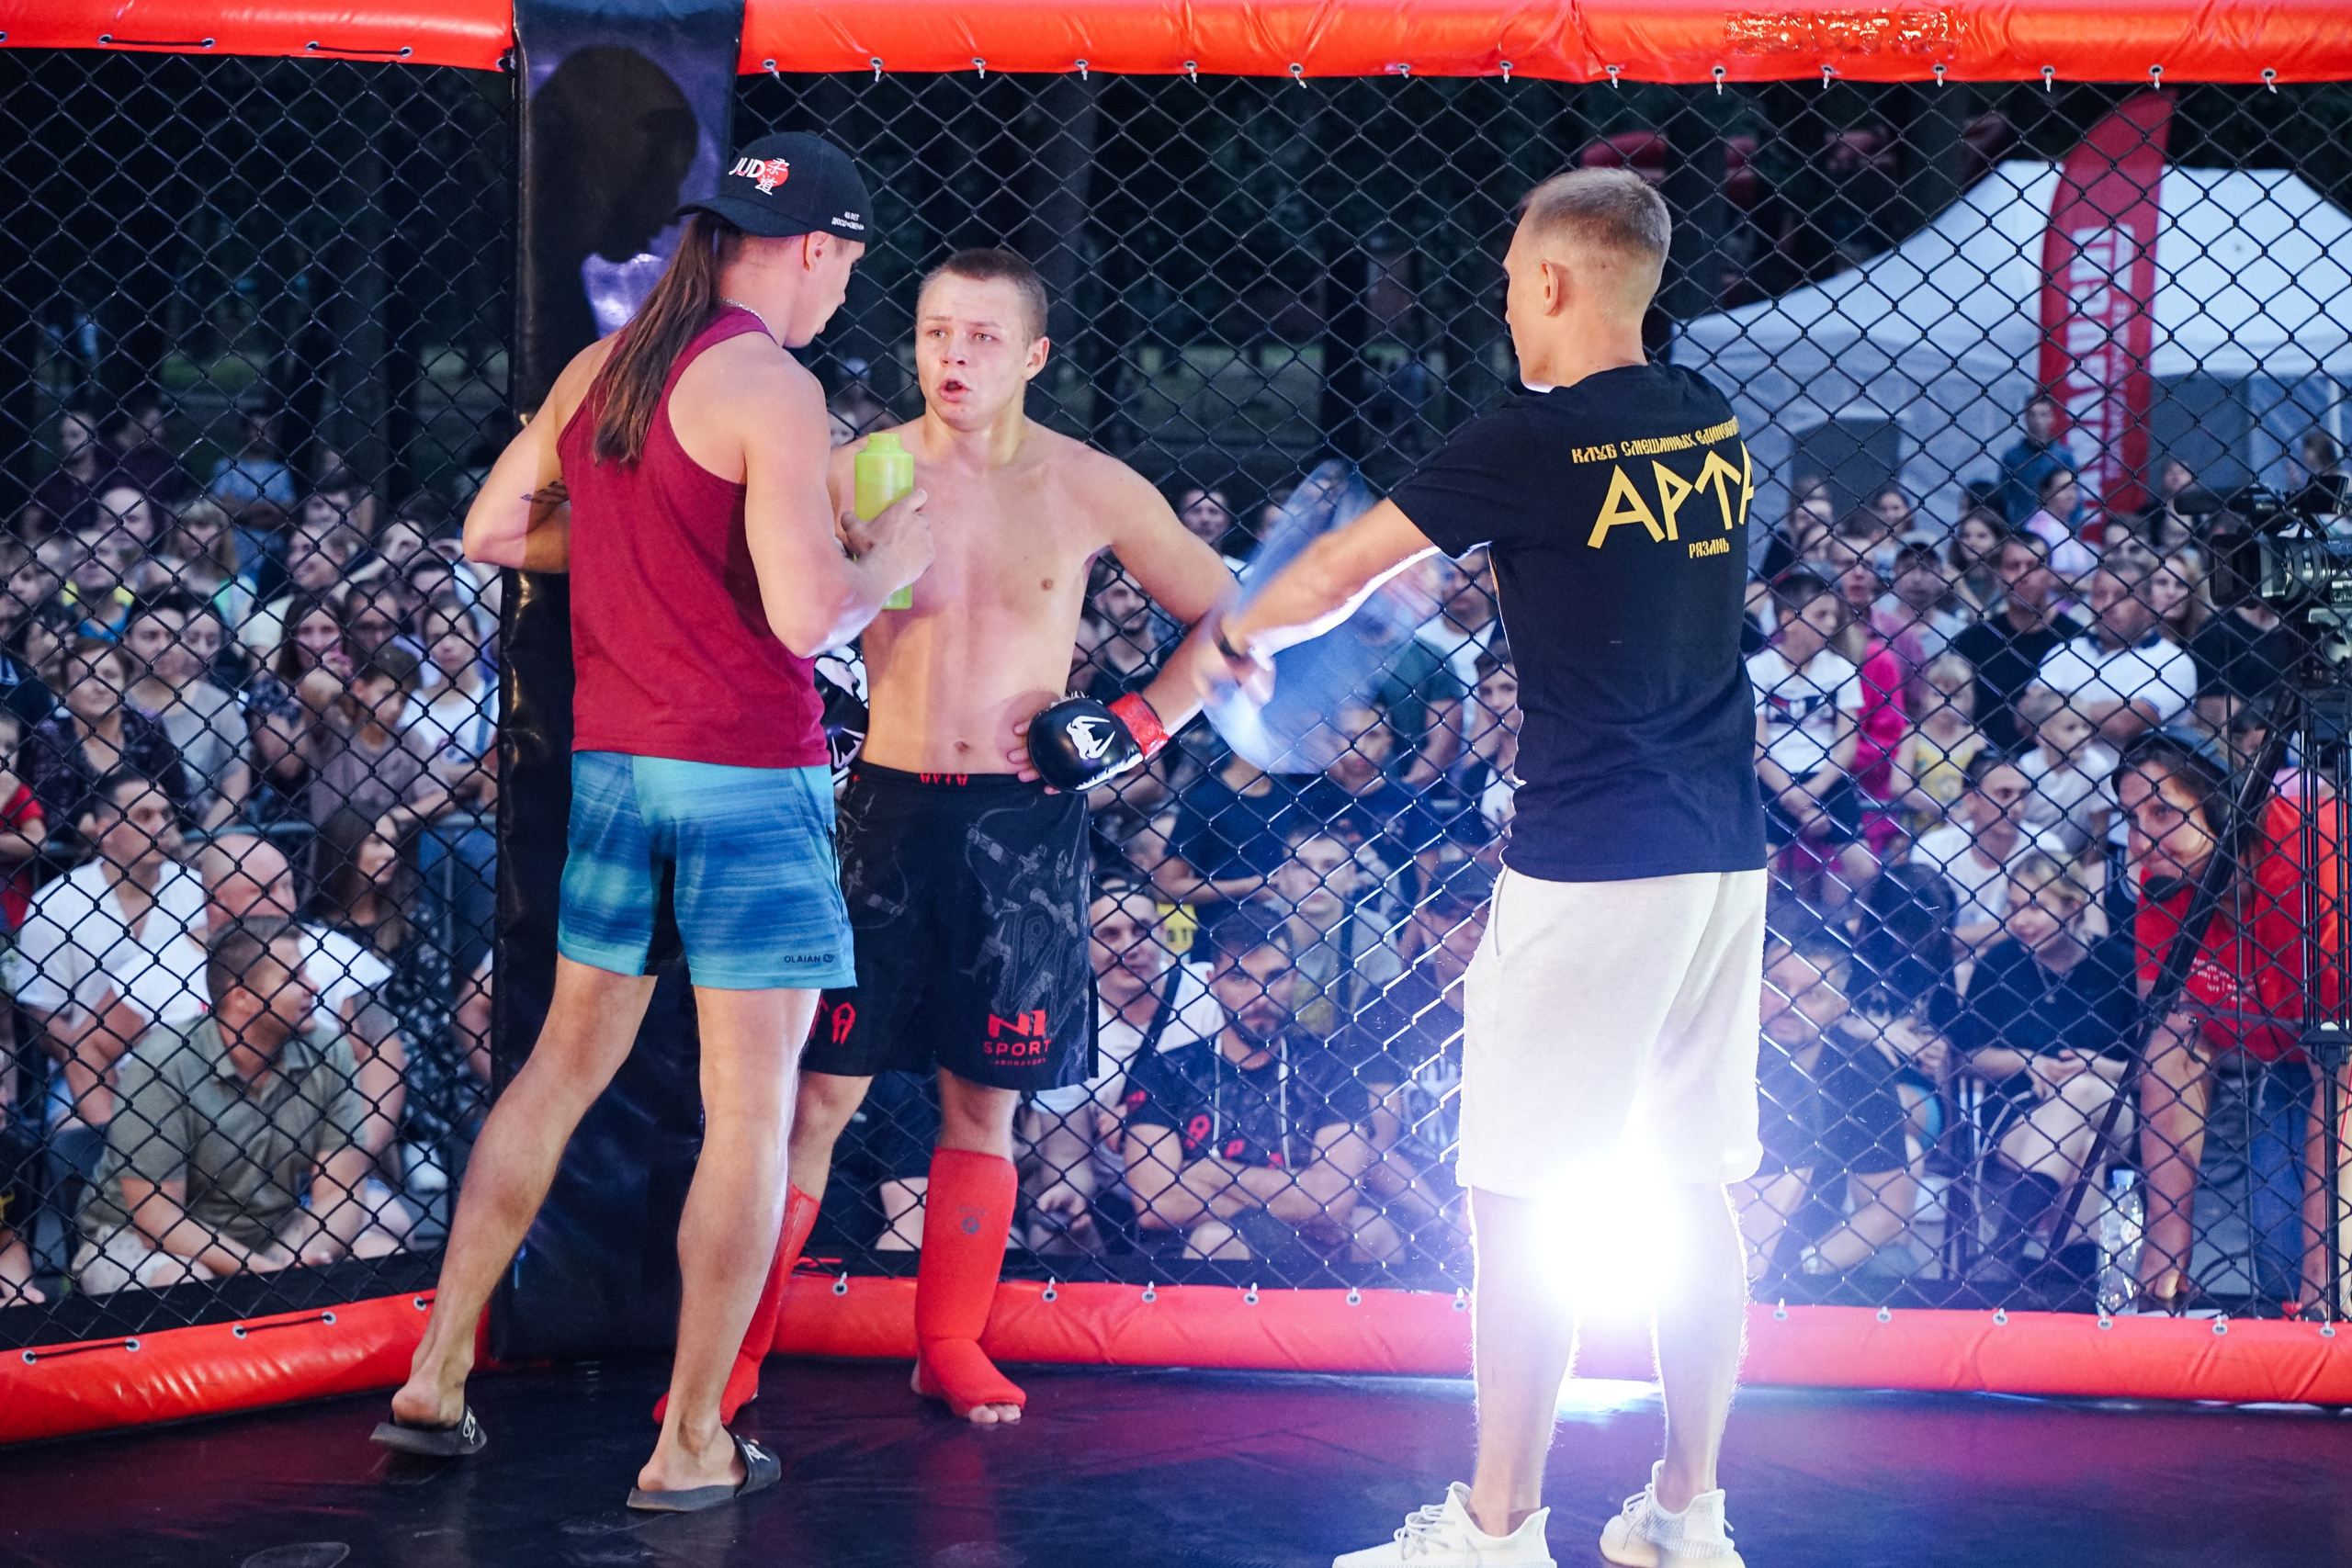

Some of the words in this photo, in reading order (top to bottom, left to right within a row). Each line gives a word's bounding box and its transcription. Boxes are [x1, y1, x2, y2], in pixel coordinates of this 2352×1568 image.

[1571, 444, 1618, 464] КЛУБ
[1689, 537, 1729, 559] РЯЗАНЬ
[784, 955, 821, 964] OLAIAN
[983, 1039, 1053, 1057] SPORT
